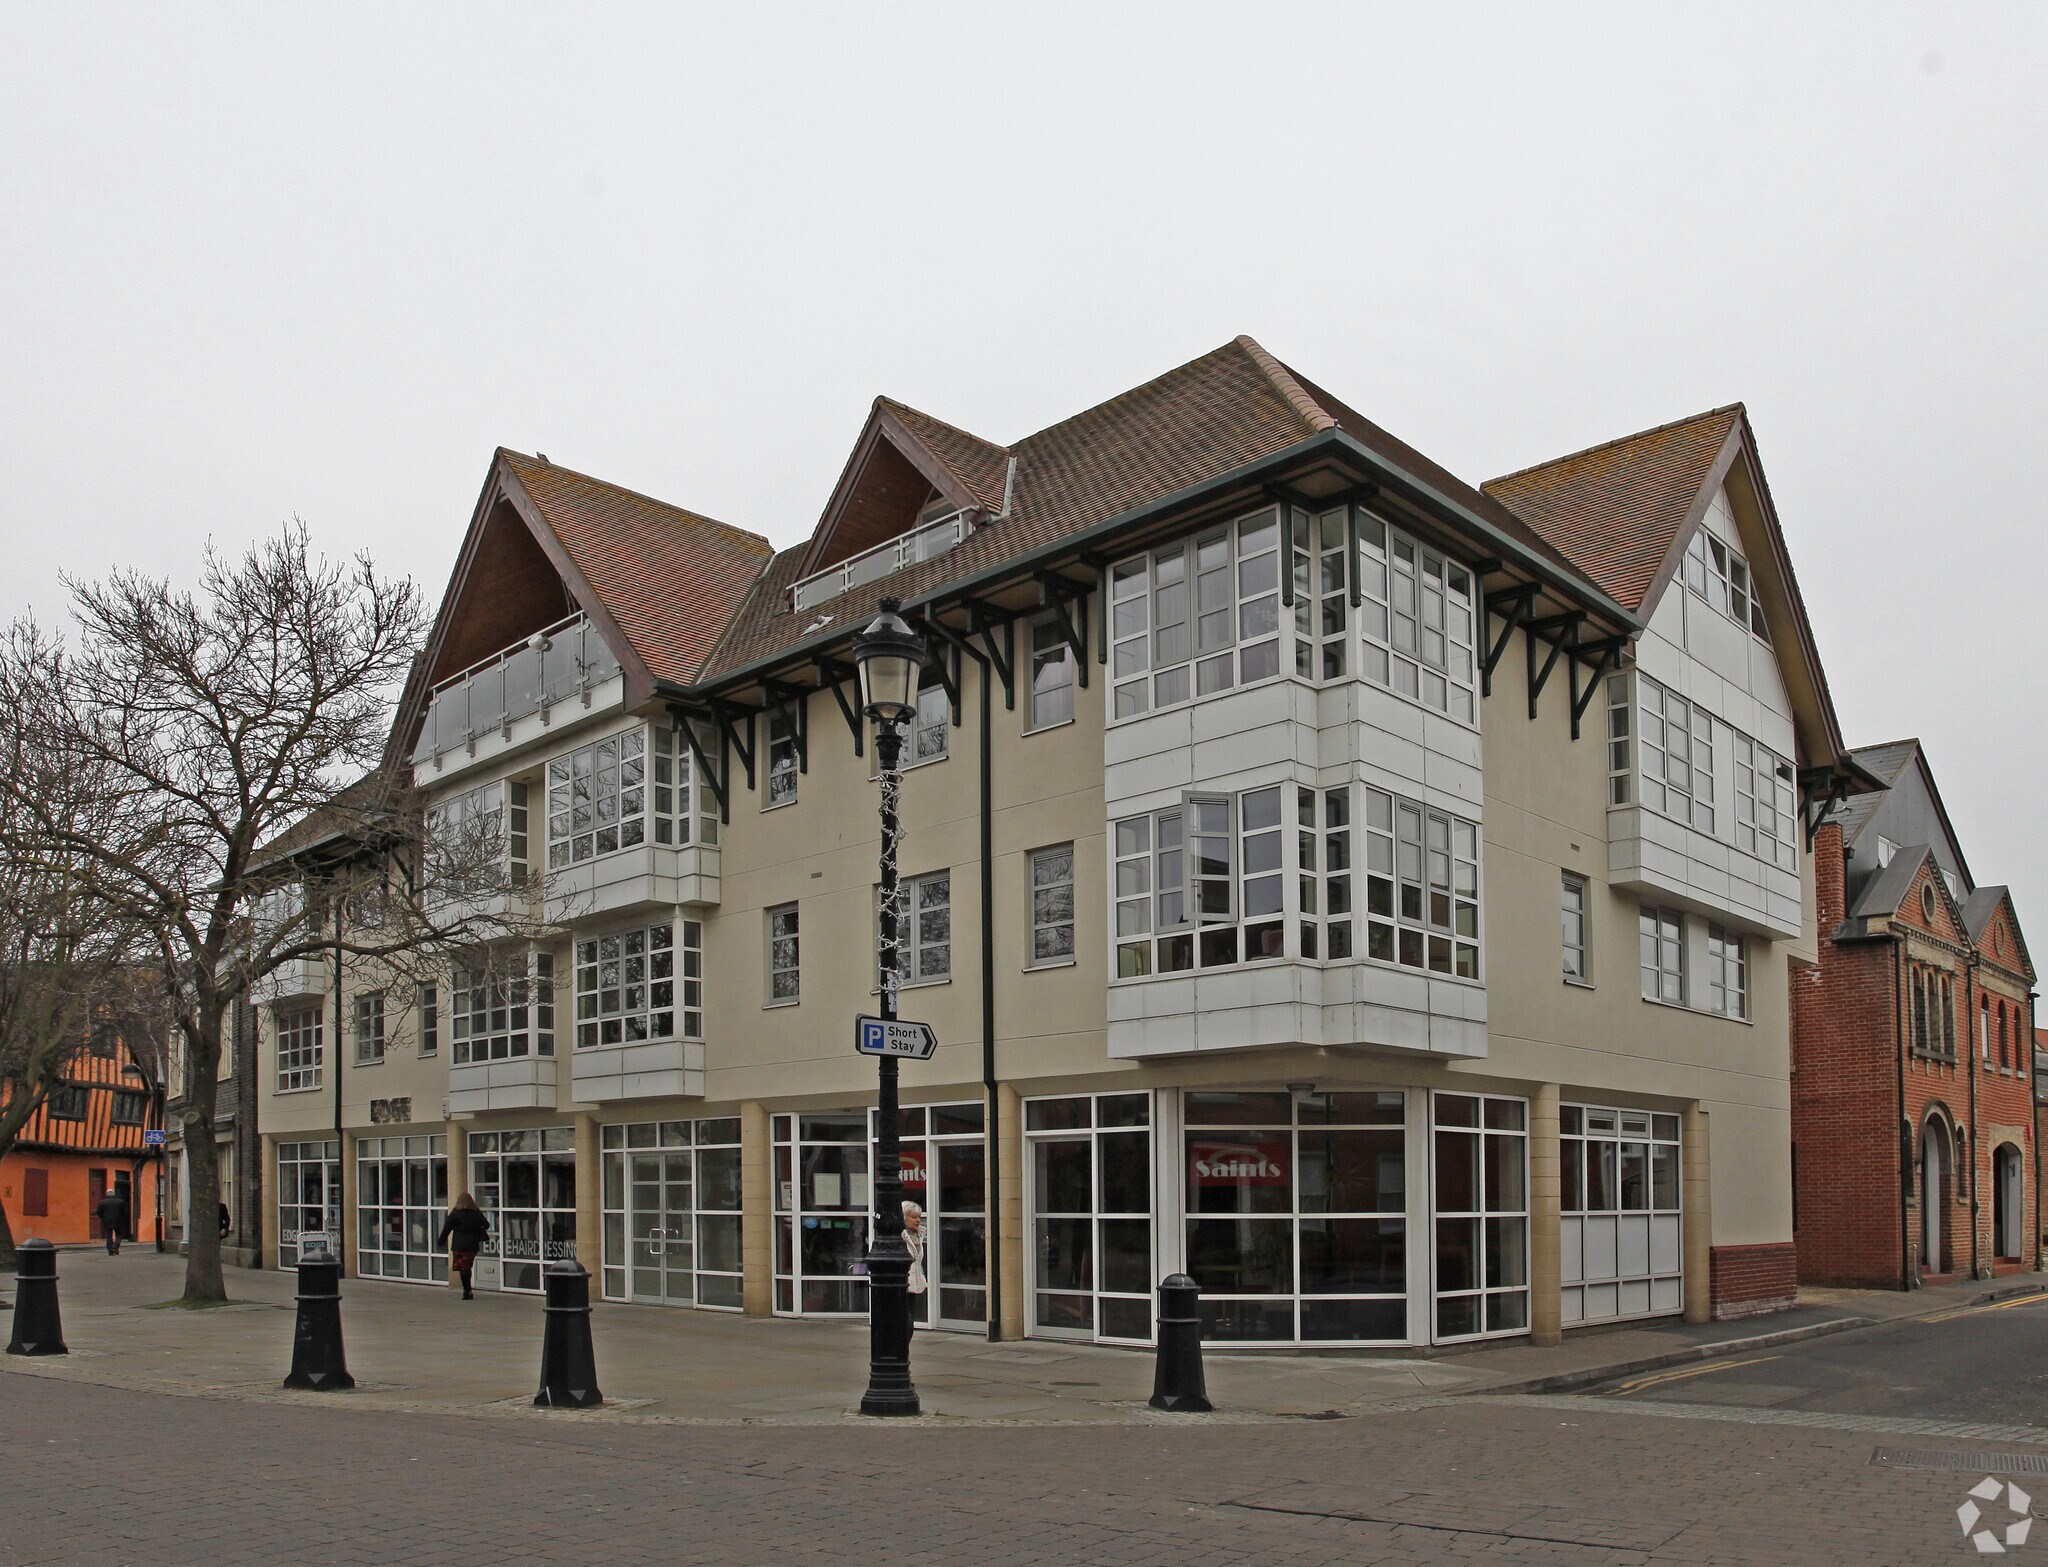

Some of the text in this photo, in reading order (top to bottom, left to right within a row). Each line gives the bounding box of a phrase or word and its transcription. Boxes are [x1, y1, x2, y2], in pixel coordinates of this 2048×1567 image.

[869, 1027, 882, 1046] P
[888, 1026, 917, 1039] Short
[891, 1039, 915, 1053] Stay
[370, 1096, 412, 1123] EDGE
[1195, 1159, 1281, 1178] Saints
[282, 1229, 300, 1242] EDG
